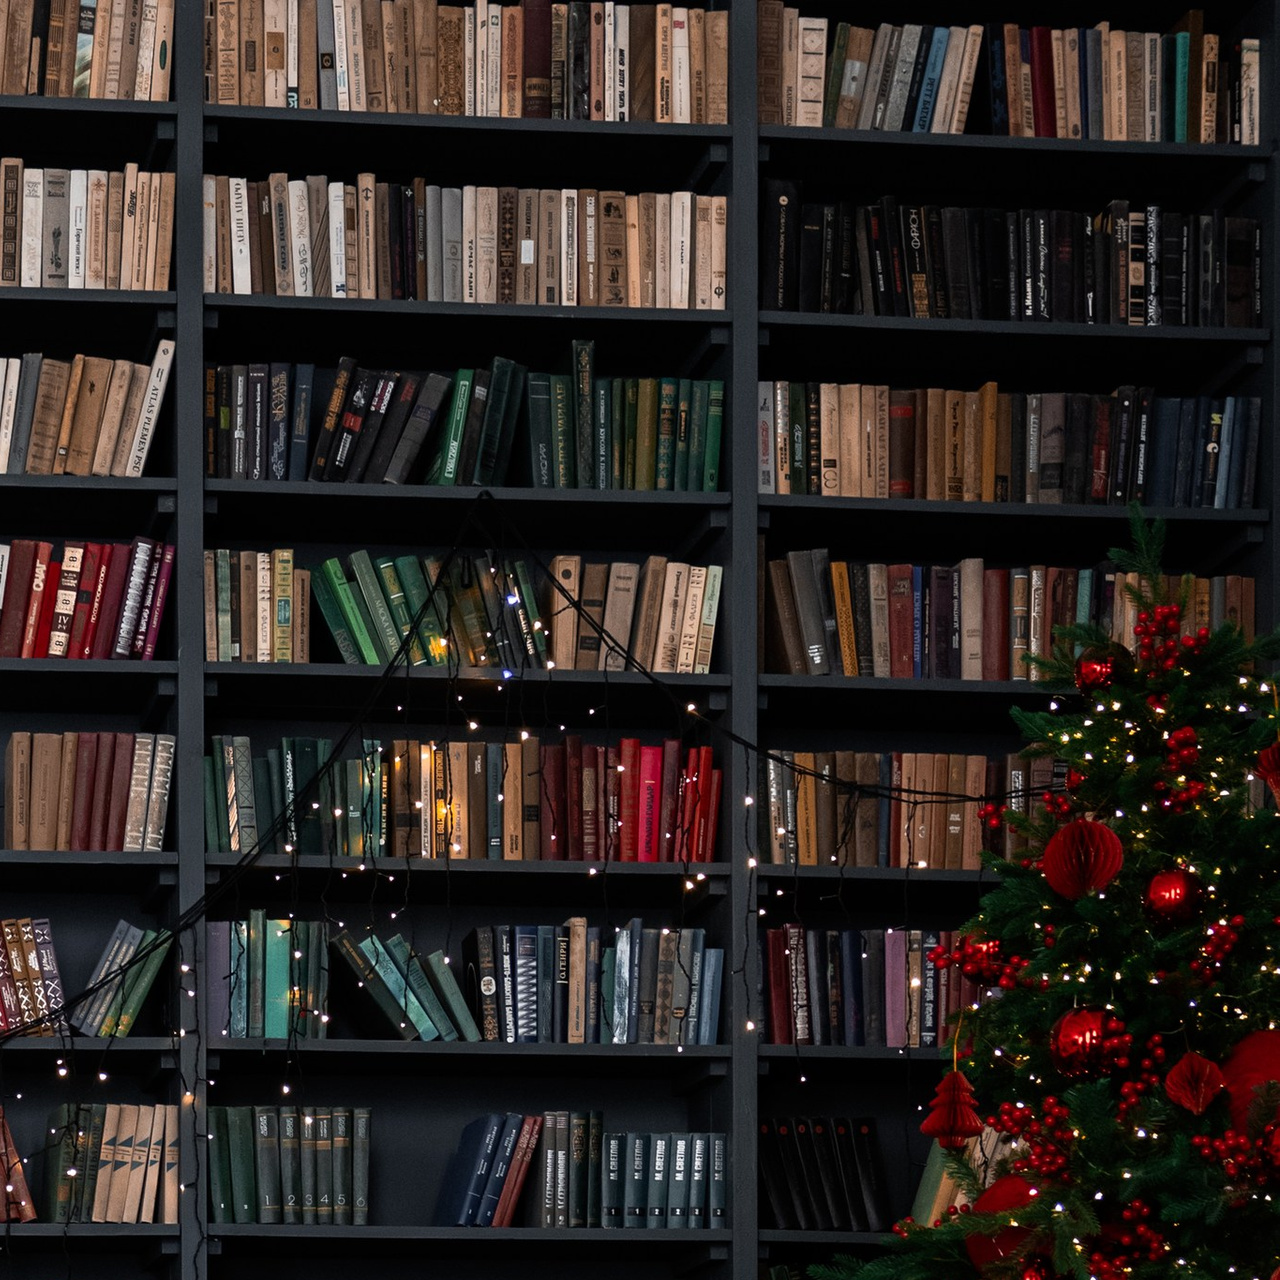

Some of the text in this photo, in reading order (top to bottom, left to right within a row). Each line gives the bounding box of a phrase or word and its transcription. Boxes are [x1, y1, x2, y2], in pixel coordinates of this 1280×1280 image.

[926, 78, 936, 96] РЕТТ
[146, 385, 161, 417] ATLAS
[138, 418, 154, 452] PLEMEN
[32, 559, 47, 592] ОЧАГ
[913, 629, 921, 662] ЛЕГЕНДЫ
[558, 941, 567, 979] О.ГЕНРИ
[610, 1140, 619, 1181] М. СВЕТЛОВ
[634, 1139, 643, 1170] СВЕТЛОВ
[655, 1140, 666, 1181] М. СВЕТЛОВ
[675, 1140, 686, 1181] М. СВЕТЛОВ
[694, 1140, 705, 1181] М. СВЕТЛОВ
[714, 1140, 723, 1170] СВЕТЛОВ
[264, 1195, 270, 1205] 1
[287, 1195, 296, 1205] 2
[305, 1194, 313, 1205] 3
[320, 1194, 329, 1204] 4
[337, 1194, 346, 1205] 5
[356, 1197, 365, 1207] 6
